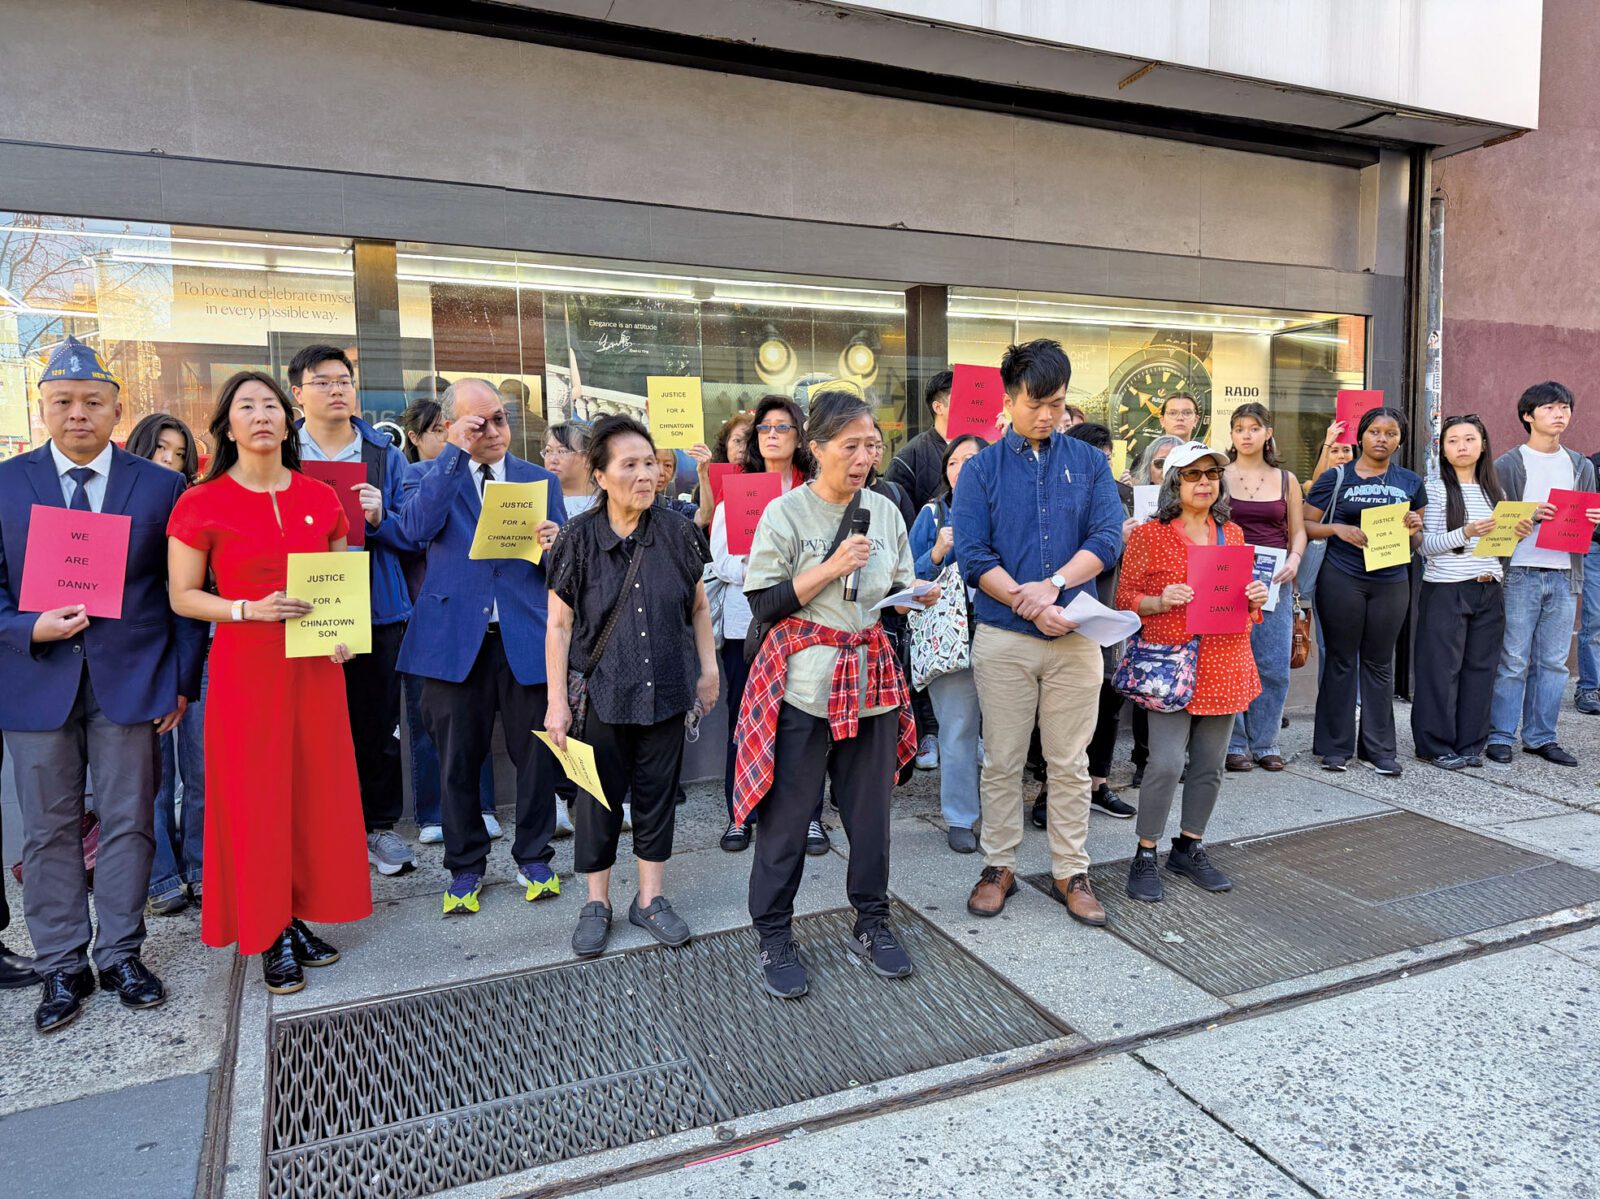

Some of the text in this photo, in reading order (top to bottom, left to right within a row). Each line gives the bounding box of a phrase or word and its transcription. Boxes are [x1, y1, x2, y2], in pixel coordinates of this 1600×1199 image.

[181, 281, 199, 296] To
[202, 282, 229, 297] love
[232, 285, 257, 299] and
[260, 287, 317, 302] celebrate
[206, 303, 339, 324] in every possible way.
[588, 319, 618, 329] Elegance
[634, 323, 658, 331] attitude
[1070, 351, 1091, 361] ONT
[1225, 386, 1259, 397] RADO
[1344, 484, 1408, 500] ANDOVER
[500, 501, 534, 509] JUSTICE
[1349, 496, 1388, 504] ATHLETICS
[1372, 516, 1395, 525] JUSTICE
[71, 531, 89, 541] WE
[1371, 542, 1401, 552] CHINATOWN
[64, 555, 89, 566] ARE
[306, 573, 345, 583] JUSTICE
[57, 579, 100, 592] DANNY
[313, 597, 331, 605] FOR
[1209, 605, 1235, 613] DANNY
[300, 618, 355, 628] CHINATOWN
[318, 630, 338, 638] SON
